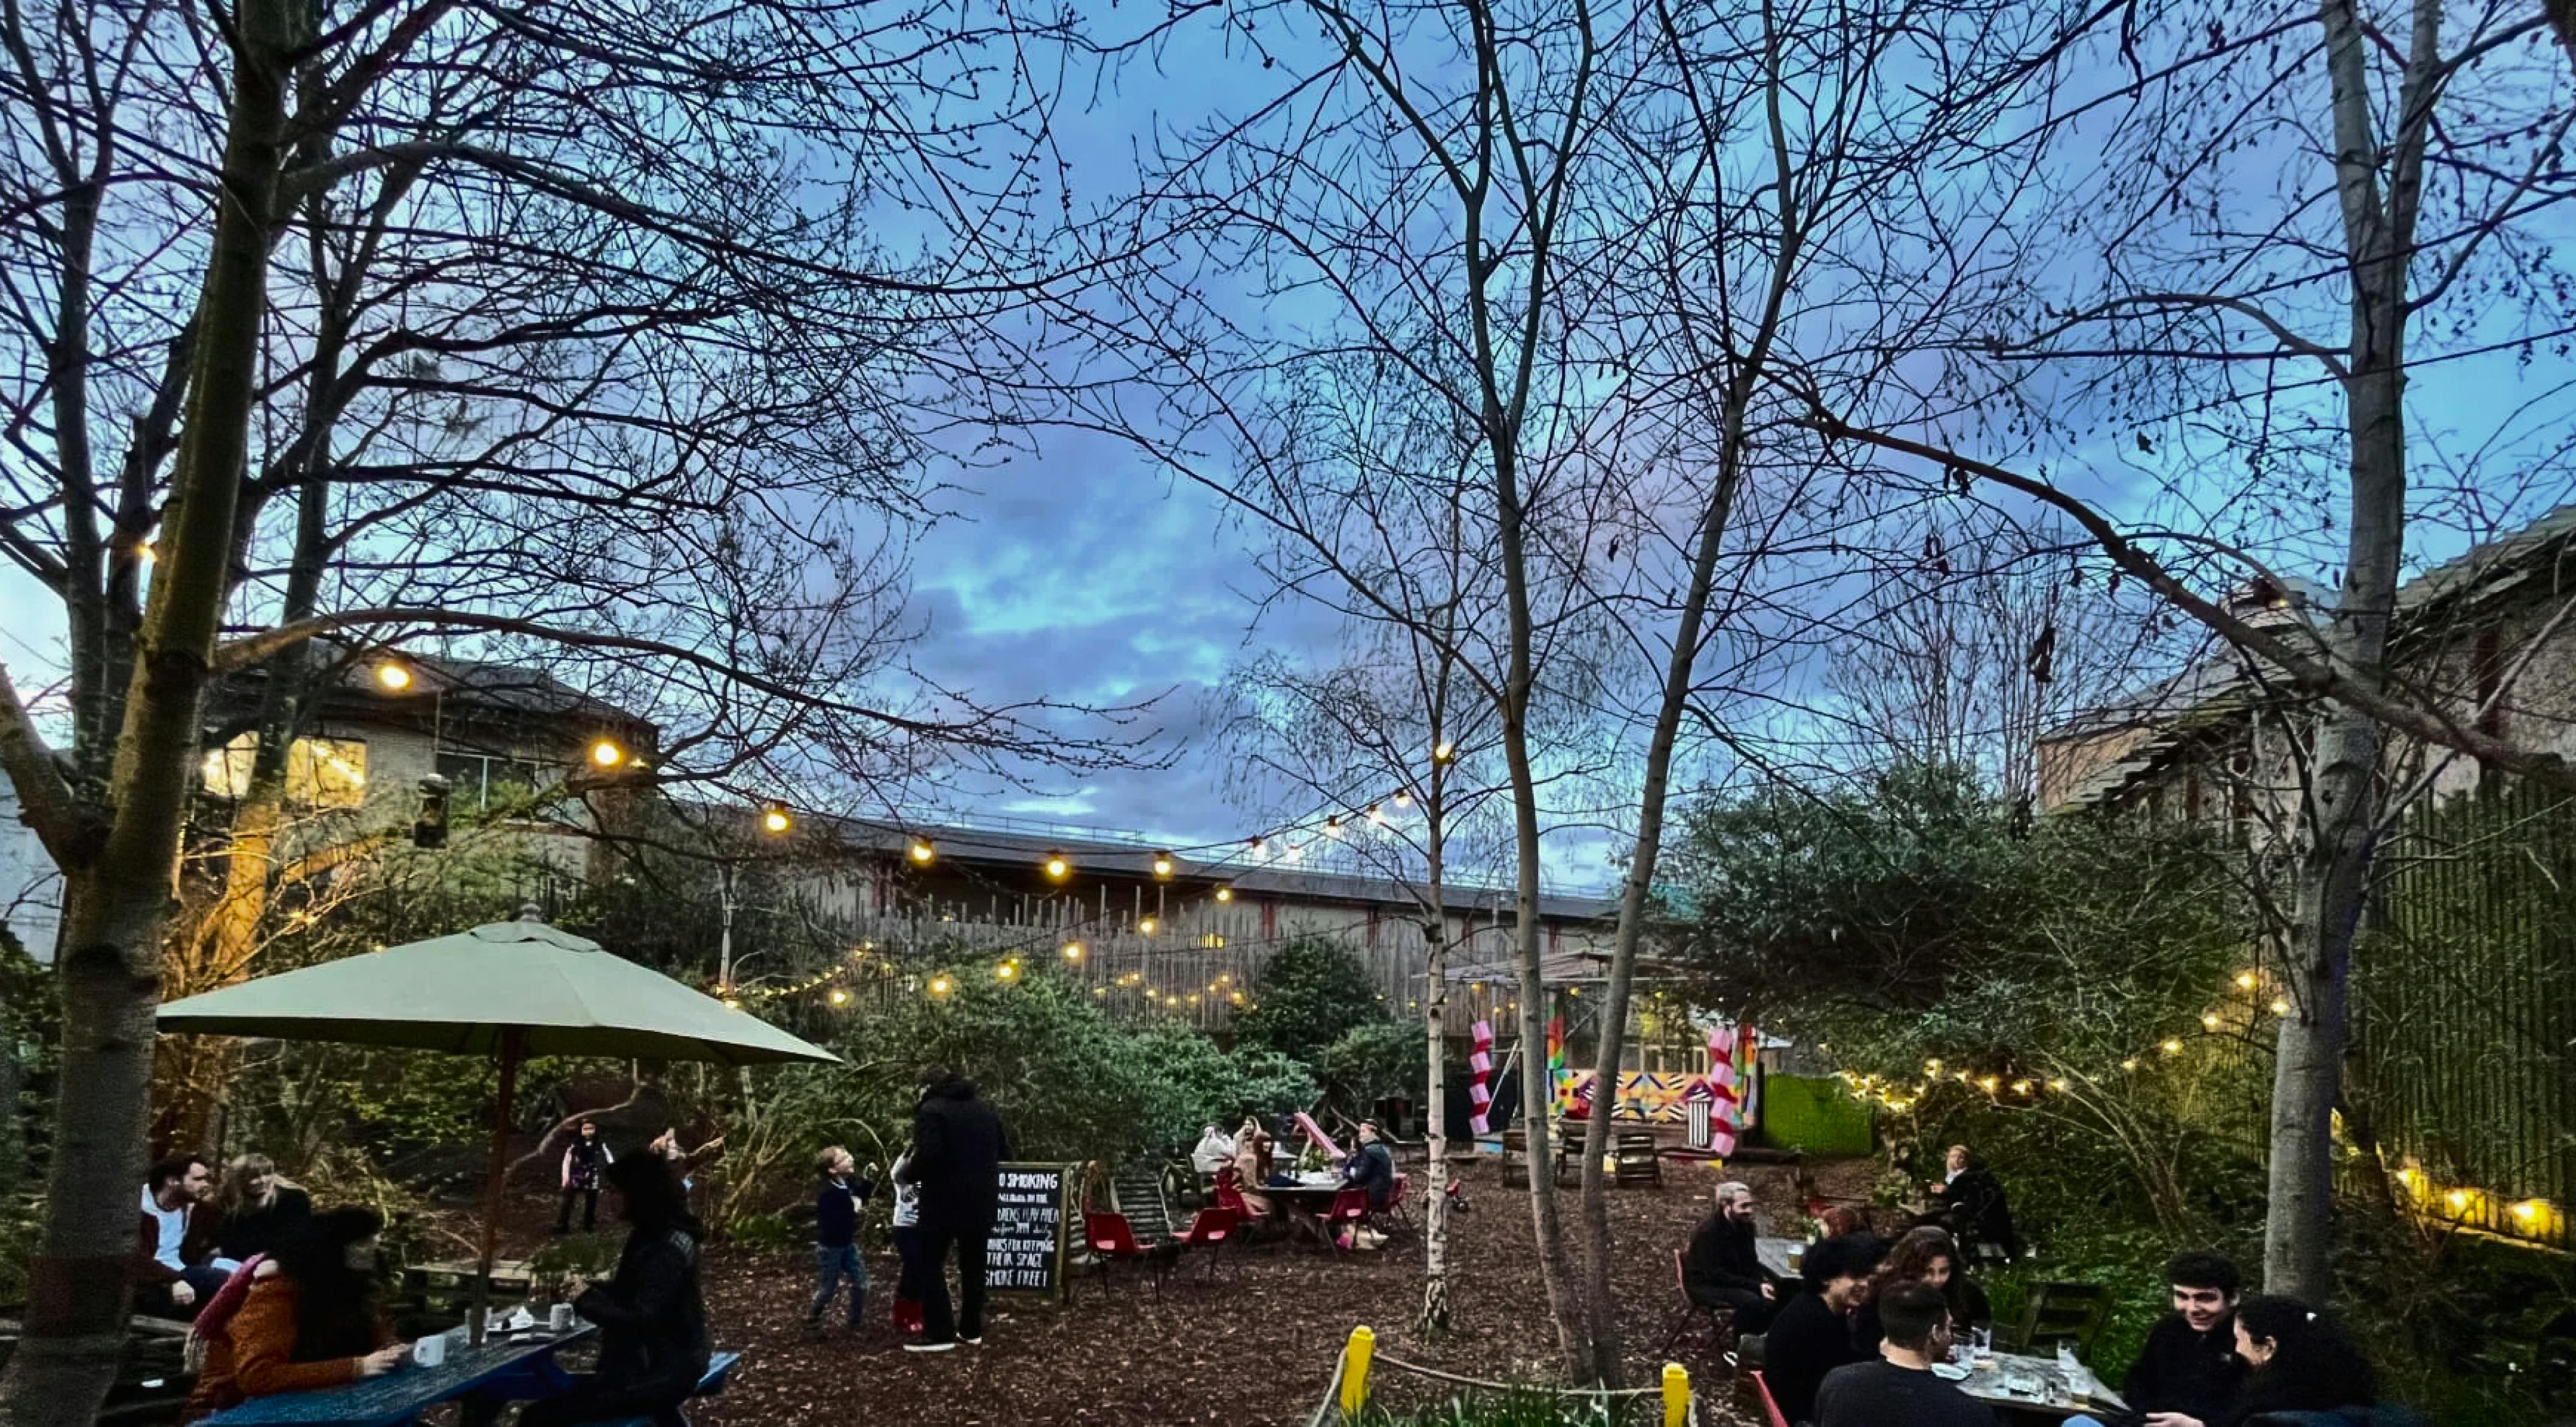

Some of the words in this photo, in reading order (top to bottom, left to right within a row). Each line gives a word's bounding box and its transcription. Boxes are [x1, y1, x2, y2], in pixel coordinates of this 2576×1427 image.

[998, 1173, 1006, 1187] O
[1007, 1173, 1058, 1189] SMOKING
[1040, 1207, 1060, 1223] AREA
[1023, 1239, 1054, 1252] KEEPING
[986, 1252, 1013, 1267] THEIR
[1017, 1253, 1042, 1268] SPACE
